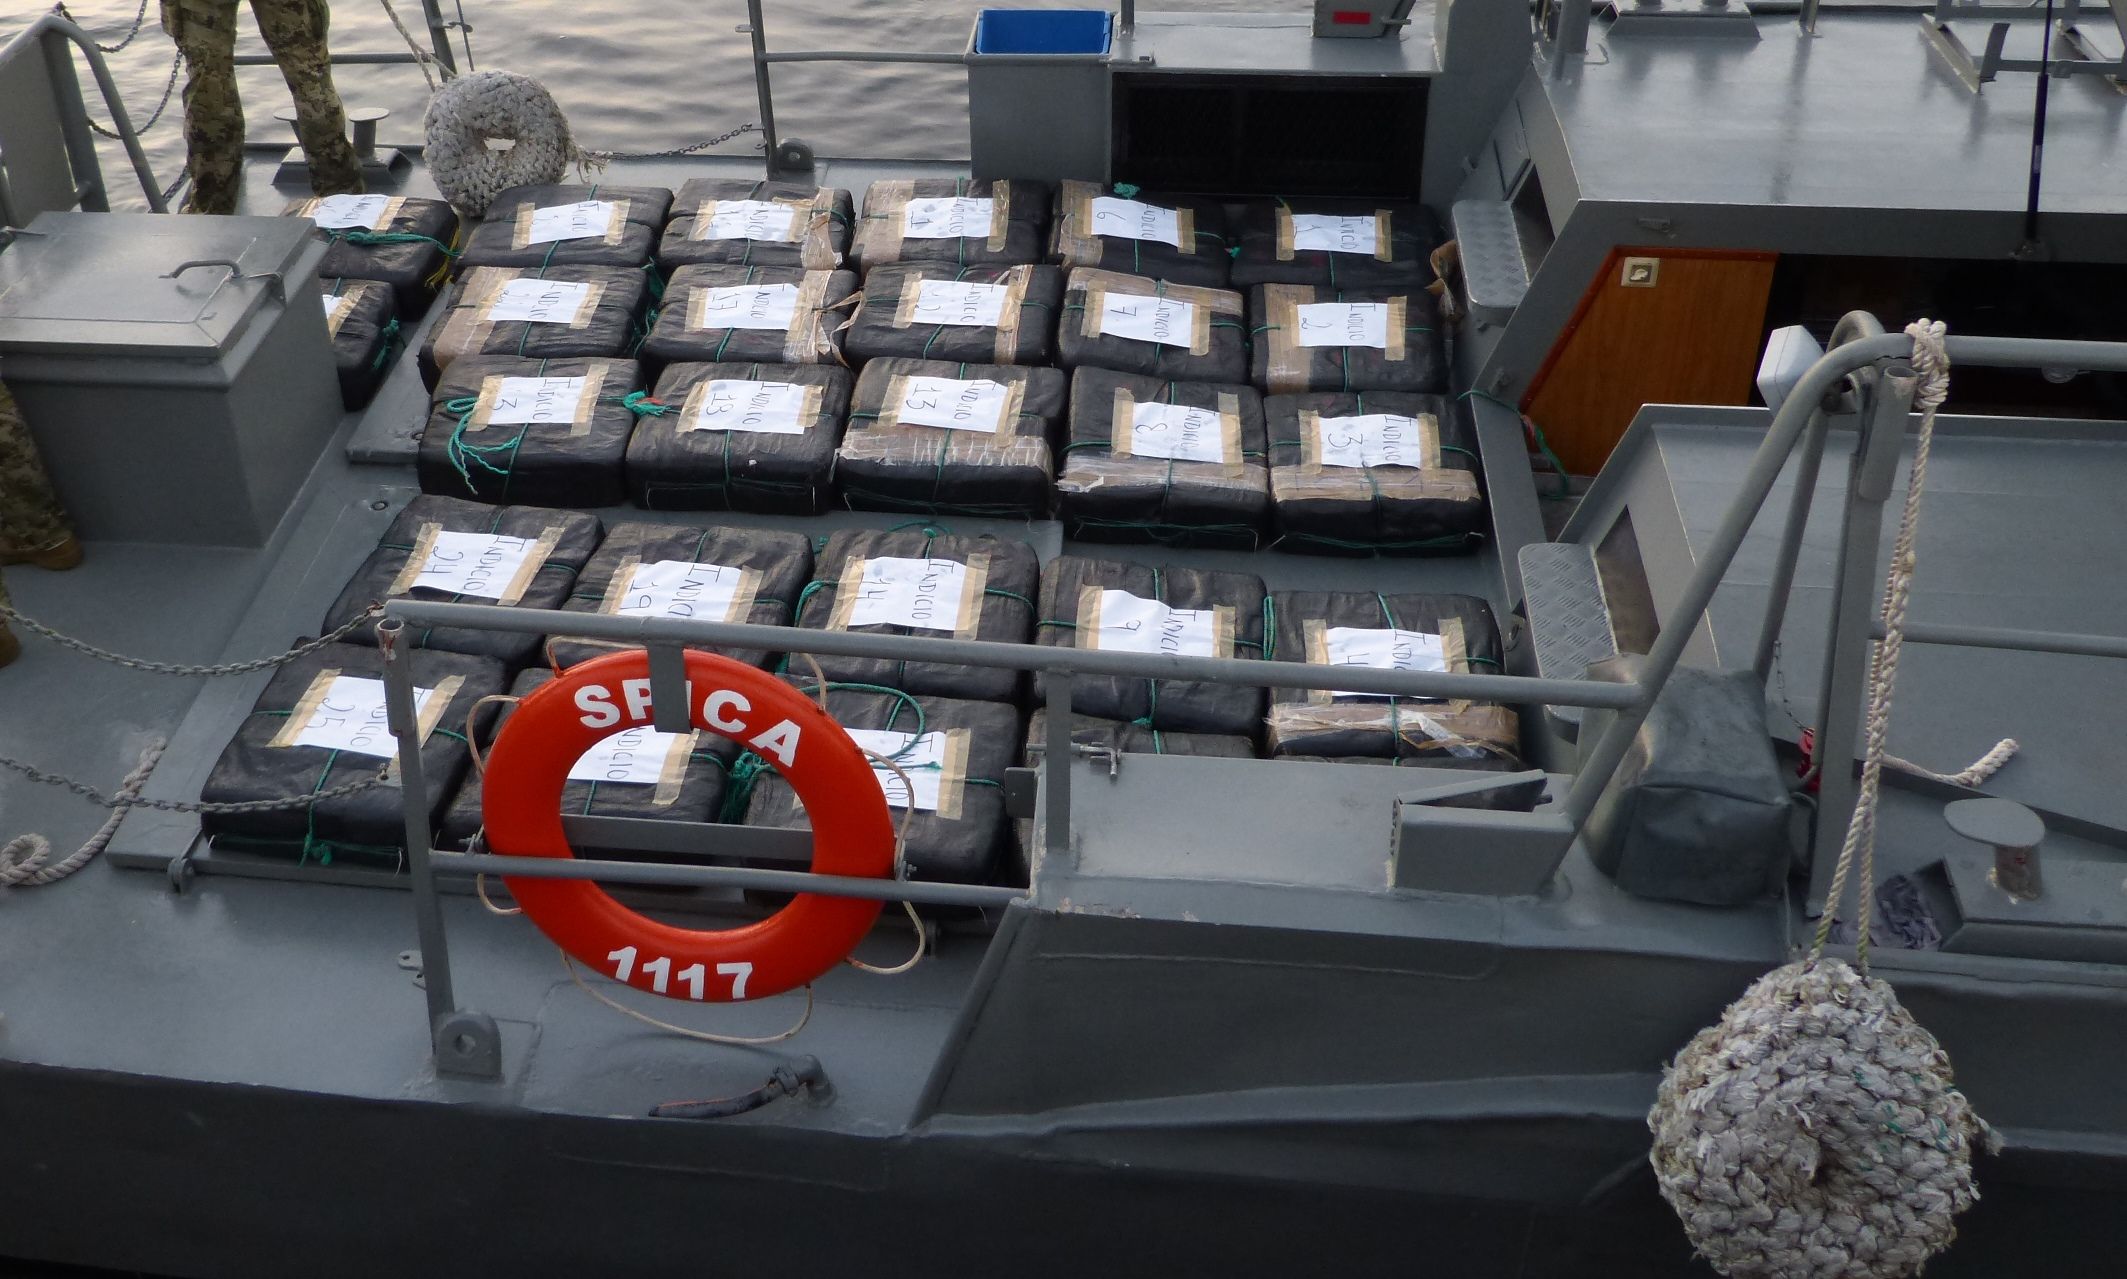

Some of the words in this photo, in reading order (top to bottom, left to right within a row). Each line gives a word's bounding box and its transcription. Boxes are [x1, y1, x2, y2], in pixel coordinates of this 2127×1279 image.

[949, 198, 978, 235] INDICIO
[1096, 211, 1126, 221] 6
[1139, 202, 1165, 238] INDICIO
[708, 292, 741, 311] 17
[750, 284, 785, 319] INDICIO
[960, 282, 993, 322] INDICIO
[1110, 306, 1136, 317] 7
[1153, 297, 1185, 338] INDICIO
[1301, 317, 1333, 330] 2
[1348, 303, 1376, 341] INDICIO
[532, 377, 572, 420] INDICIO
[742, 382, 790, 424] INDICIO
[905, 382, 937, 410] 13
[953, 379, 997, 420] INDICIO
[1135, 421, 1167, 433] 8
[1178, 405, 1216, 449] INDICIO
[1328, 432, 1364, 449] 3
[1382, 414, 1414, 462] INDICIO
[422, 545, 464, 574] 24
[463, 535, 528, 591] INDICIO
[620, 579, 657, 610] 19
[667, 563, 723, 618] INDICI
[854, 571, 892, 600] 14
[911, 558, 955, 620] INDICIO
[1103, 620, 1141, 631] 9
[1160, 608, 1197, 655] INDICI
[1347, 653, 1370, 665] 4
[1392, 630, 1427, 669] INDIC
[301, 697, 356, 729] 25
[606, 727, 648, 780] NDICIO
[607, 945, 753, 1000] 1117
